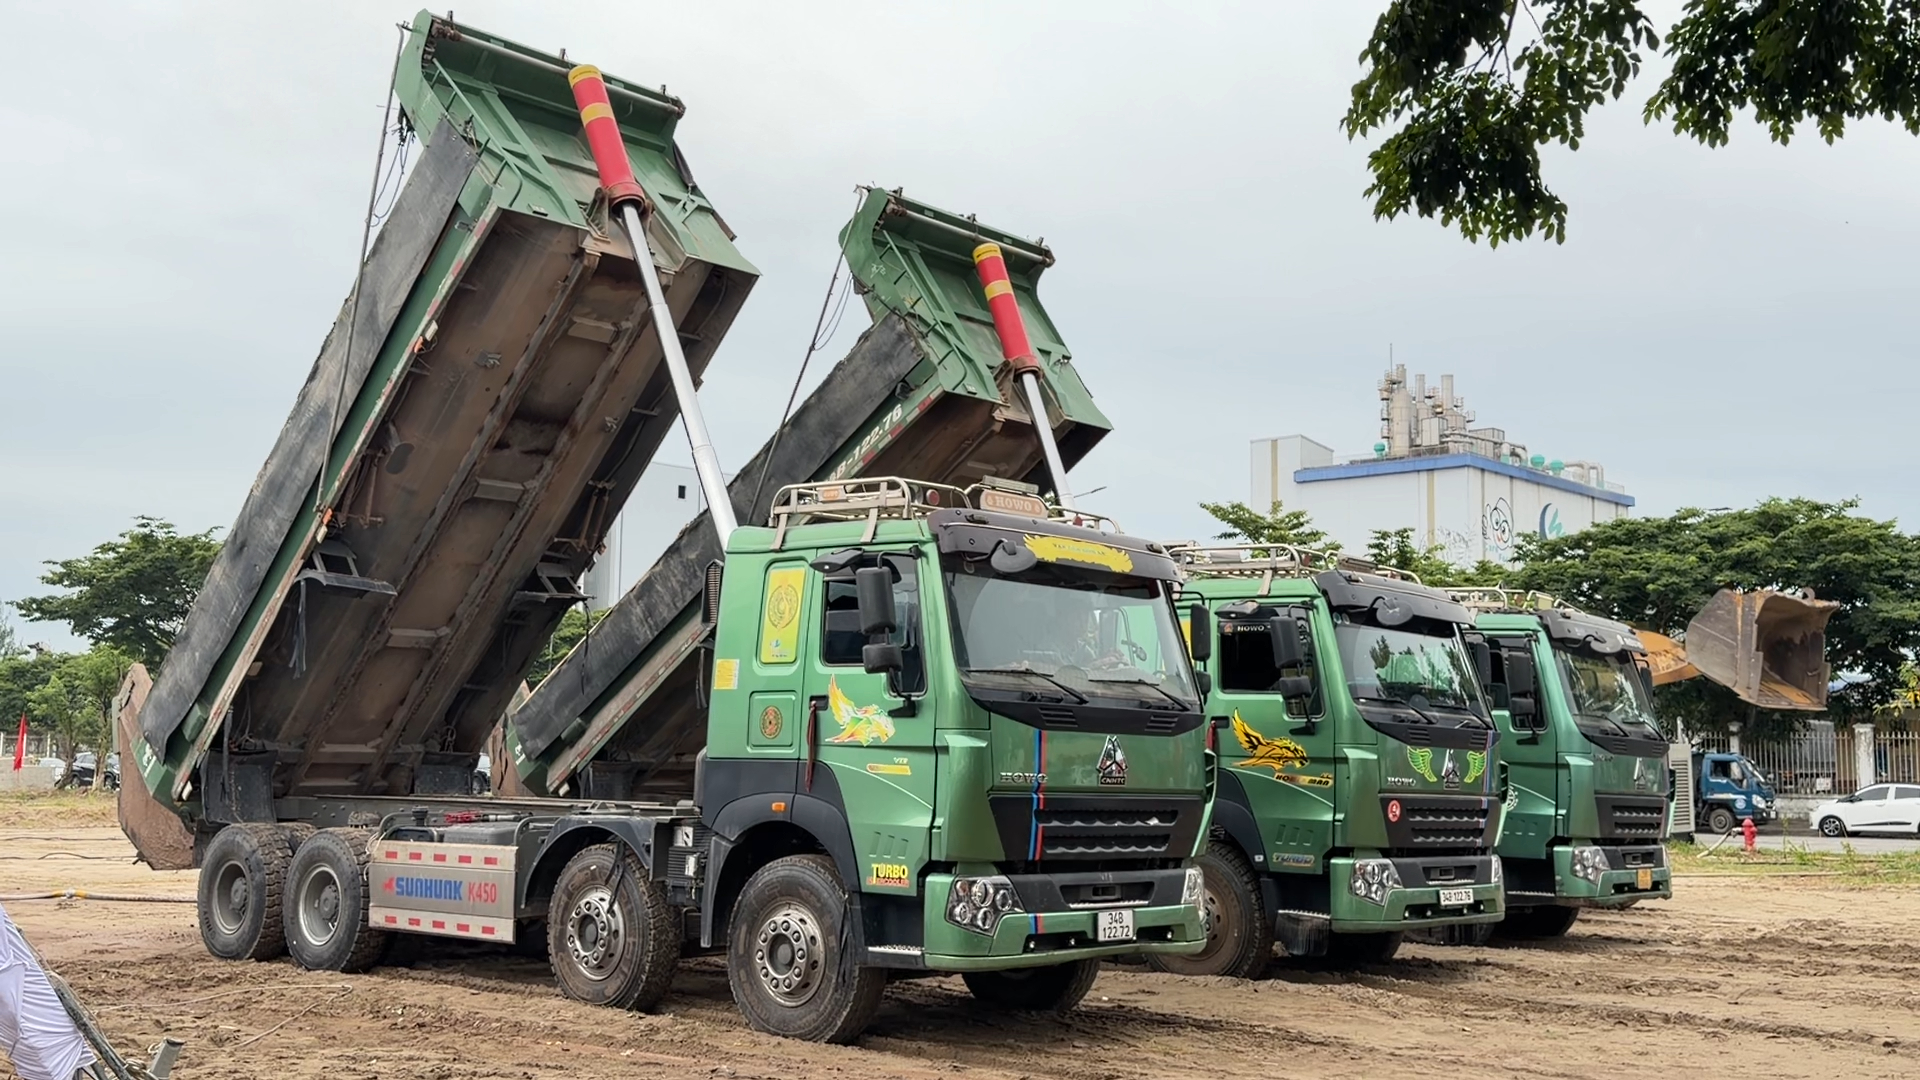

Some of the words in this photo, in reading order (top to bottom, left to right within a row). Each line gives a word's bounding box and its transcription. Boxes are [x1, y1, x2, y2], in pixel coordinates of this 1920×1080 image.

[994, 495, 1032, 512] HOWO
[1000, 772, 1047, 784] HOWO
[1387, 777, 1416, 786] HOWO
[871, 863, 908, 880] TURBO
[468, 882, 497, 903] K450
[1108, 912, 1123, 925] 34B
[1103, 925, 1130, 938] 122.72
